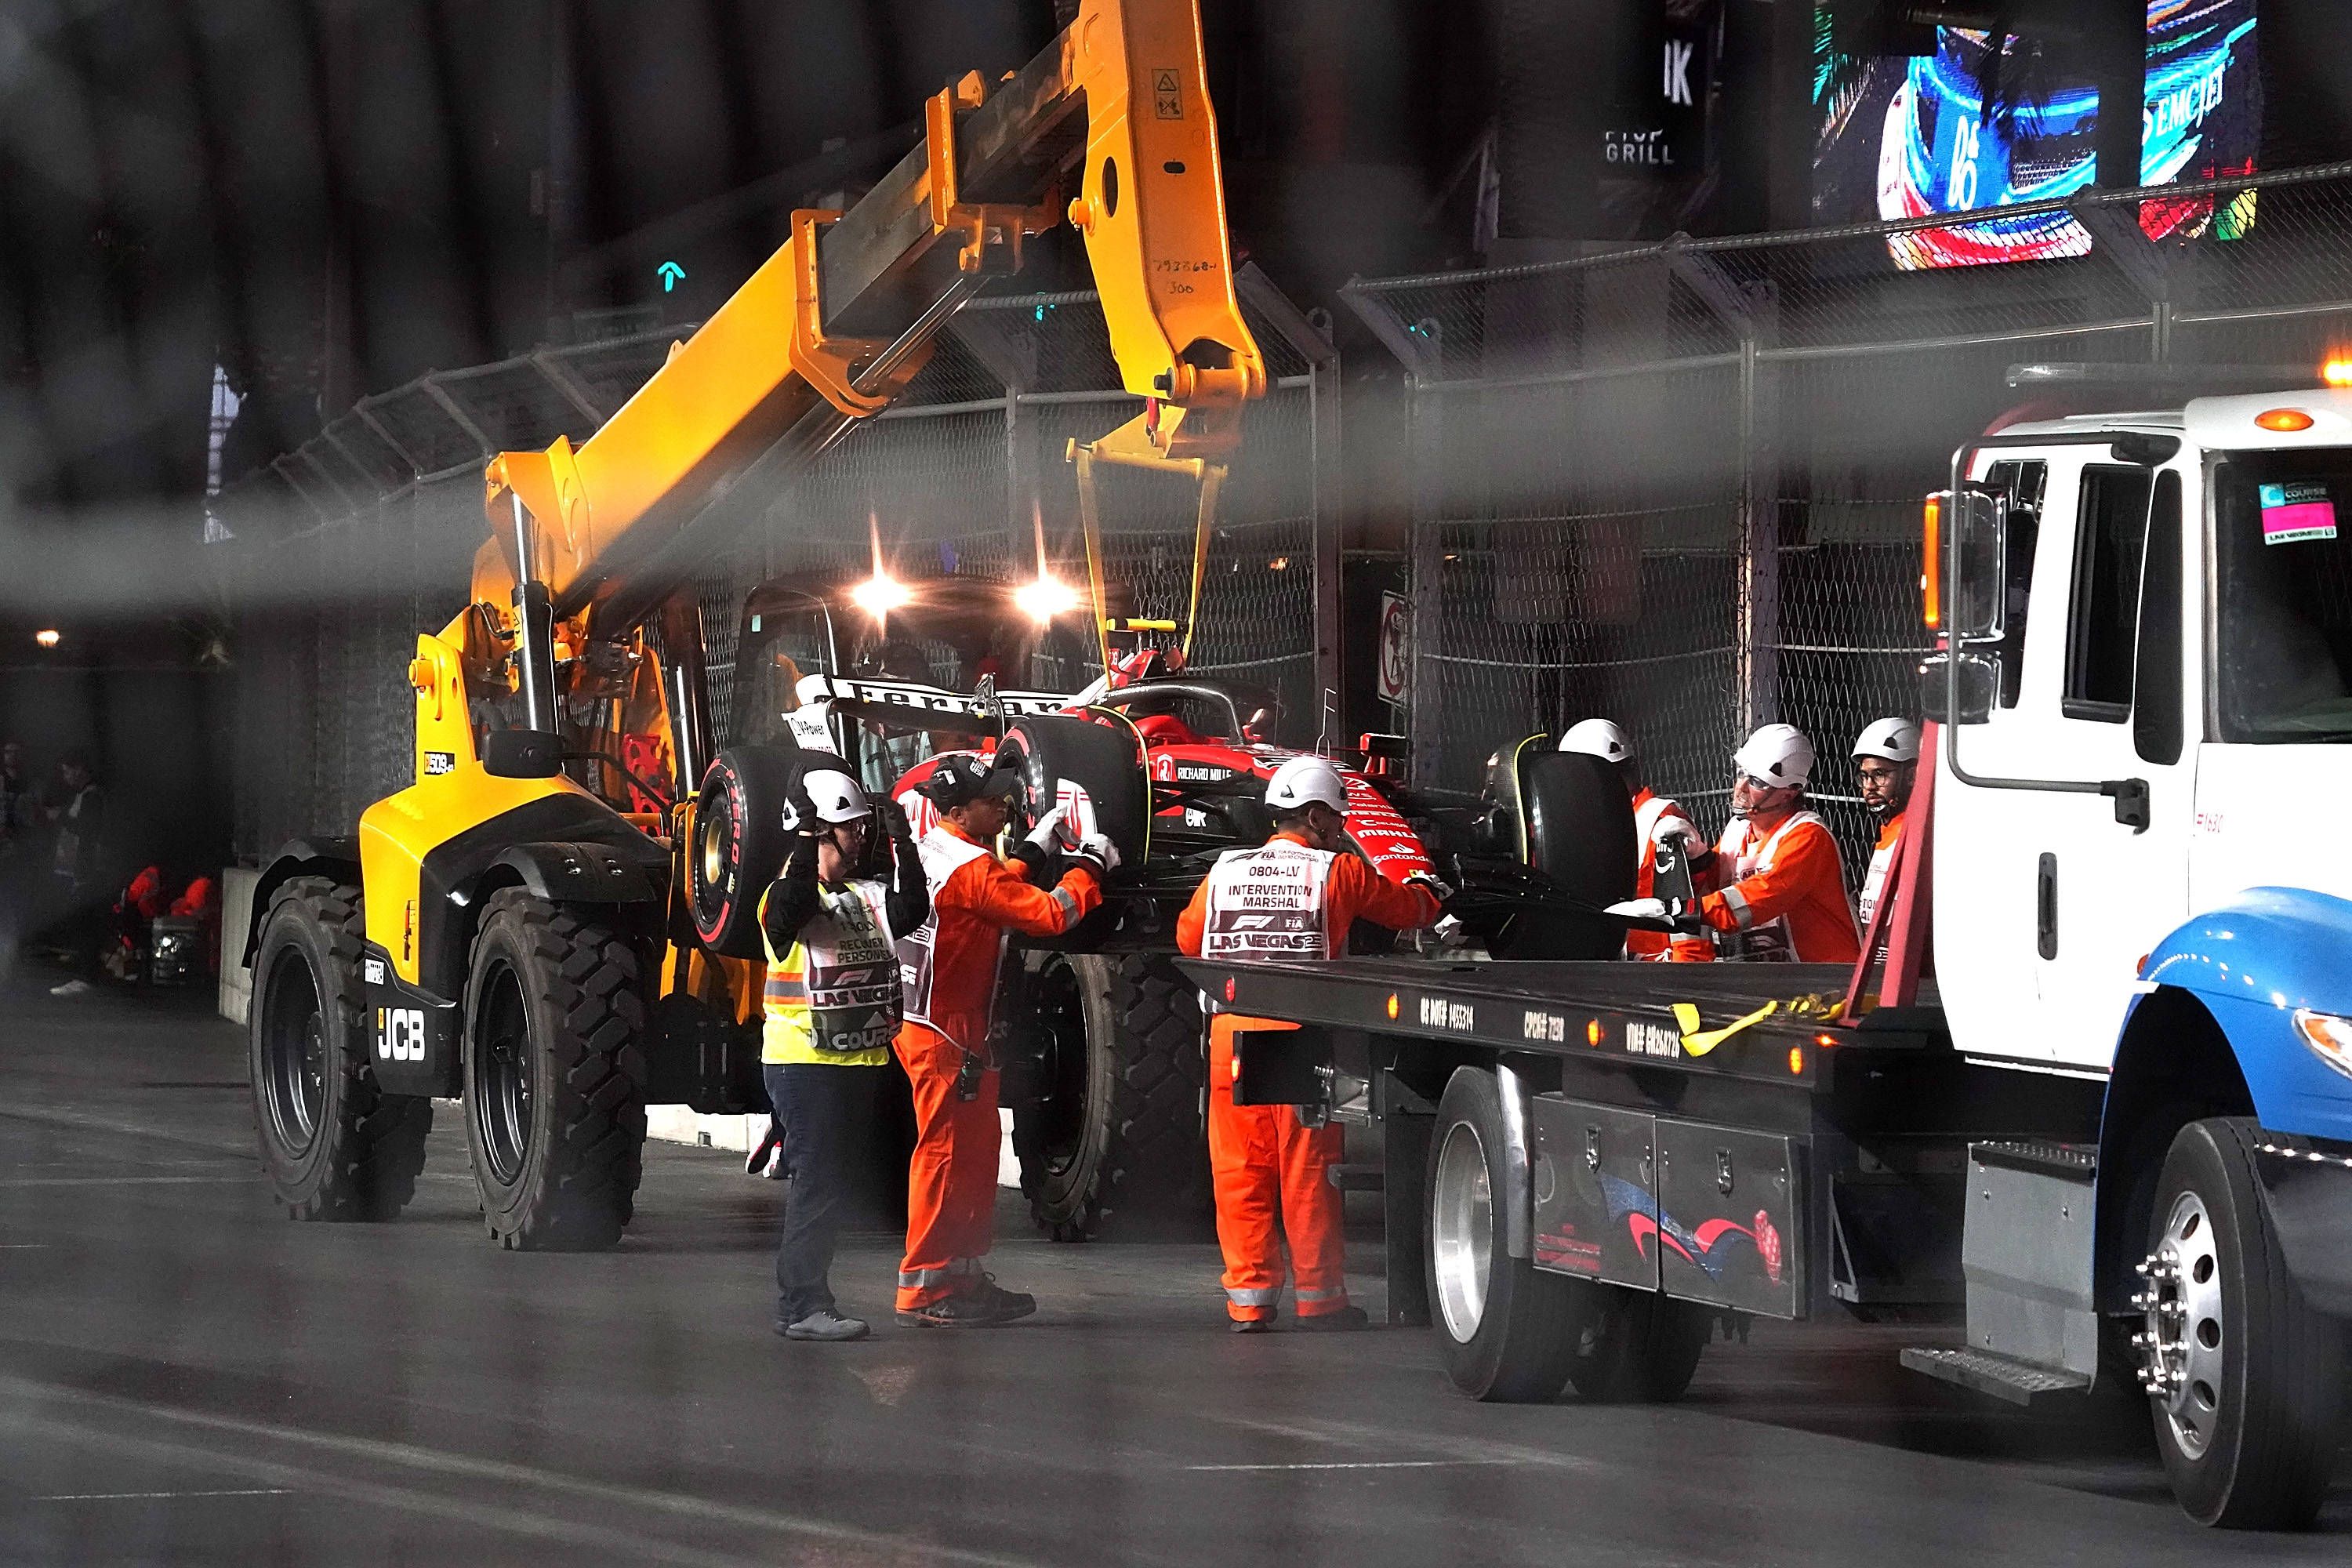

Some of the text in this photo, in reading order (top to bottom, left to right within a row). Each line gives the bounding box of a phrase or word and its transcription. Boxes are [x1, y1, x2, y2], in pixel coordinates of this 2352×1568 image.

[1606, 143, 1675, 164] GRILL
[848, 681, 1069, 717] Ferrar
[797, 720, 825, 735] V-Power
[1178, 767, 1208, 780] RICHARD
[730, 786, 741, 865] ZERO
[1373, 853, 1433, 865] Santand
[1249, 866, 1300, 877] 0804-LV
[1229, 884, 1312, 897] INTERVENTION
[1243, 897, 1300, 908] MARSHAL
[1284, 917, 1304, 929] FIA
[1210, 935, 1242, 950] LAS
[1244, 934, 1305, 949] VEGAS
[1421, 997, 1430, 1025] US
[377, 1007, 426, 1061] JCB
[832, 1023, 902, 1051] COURS
